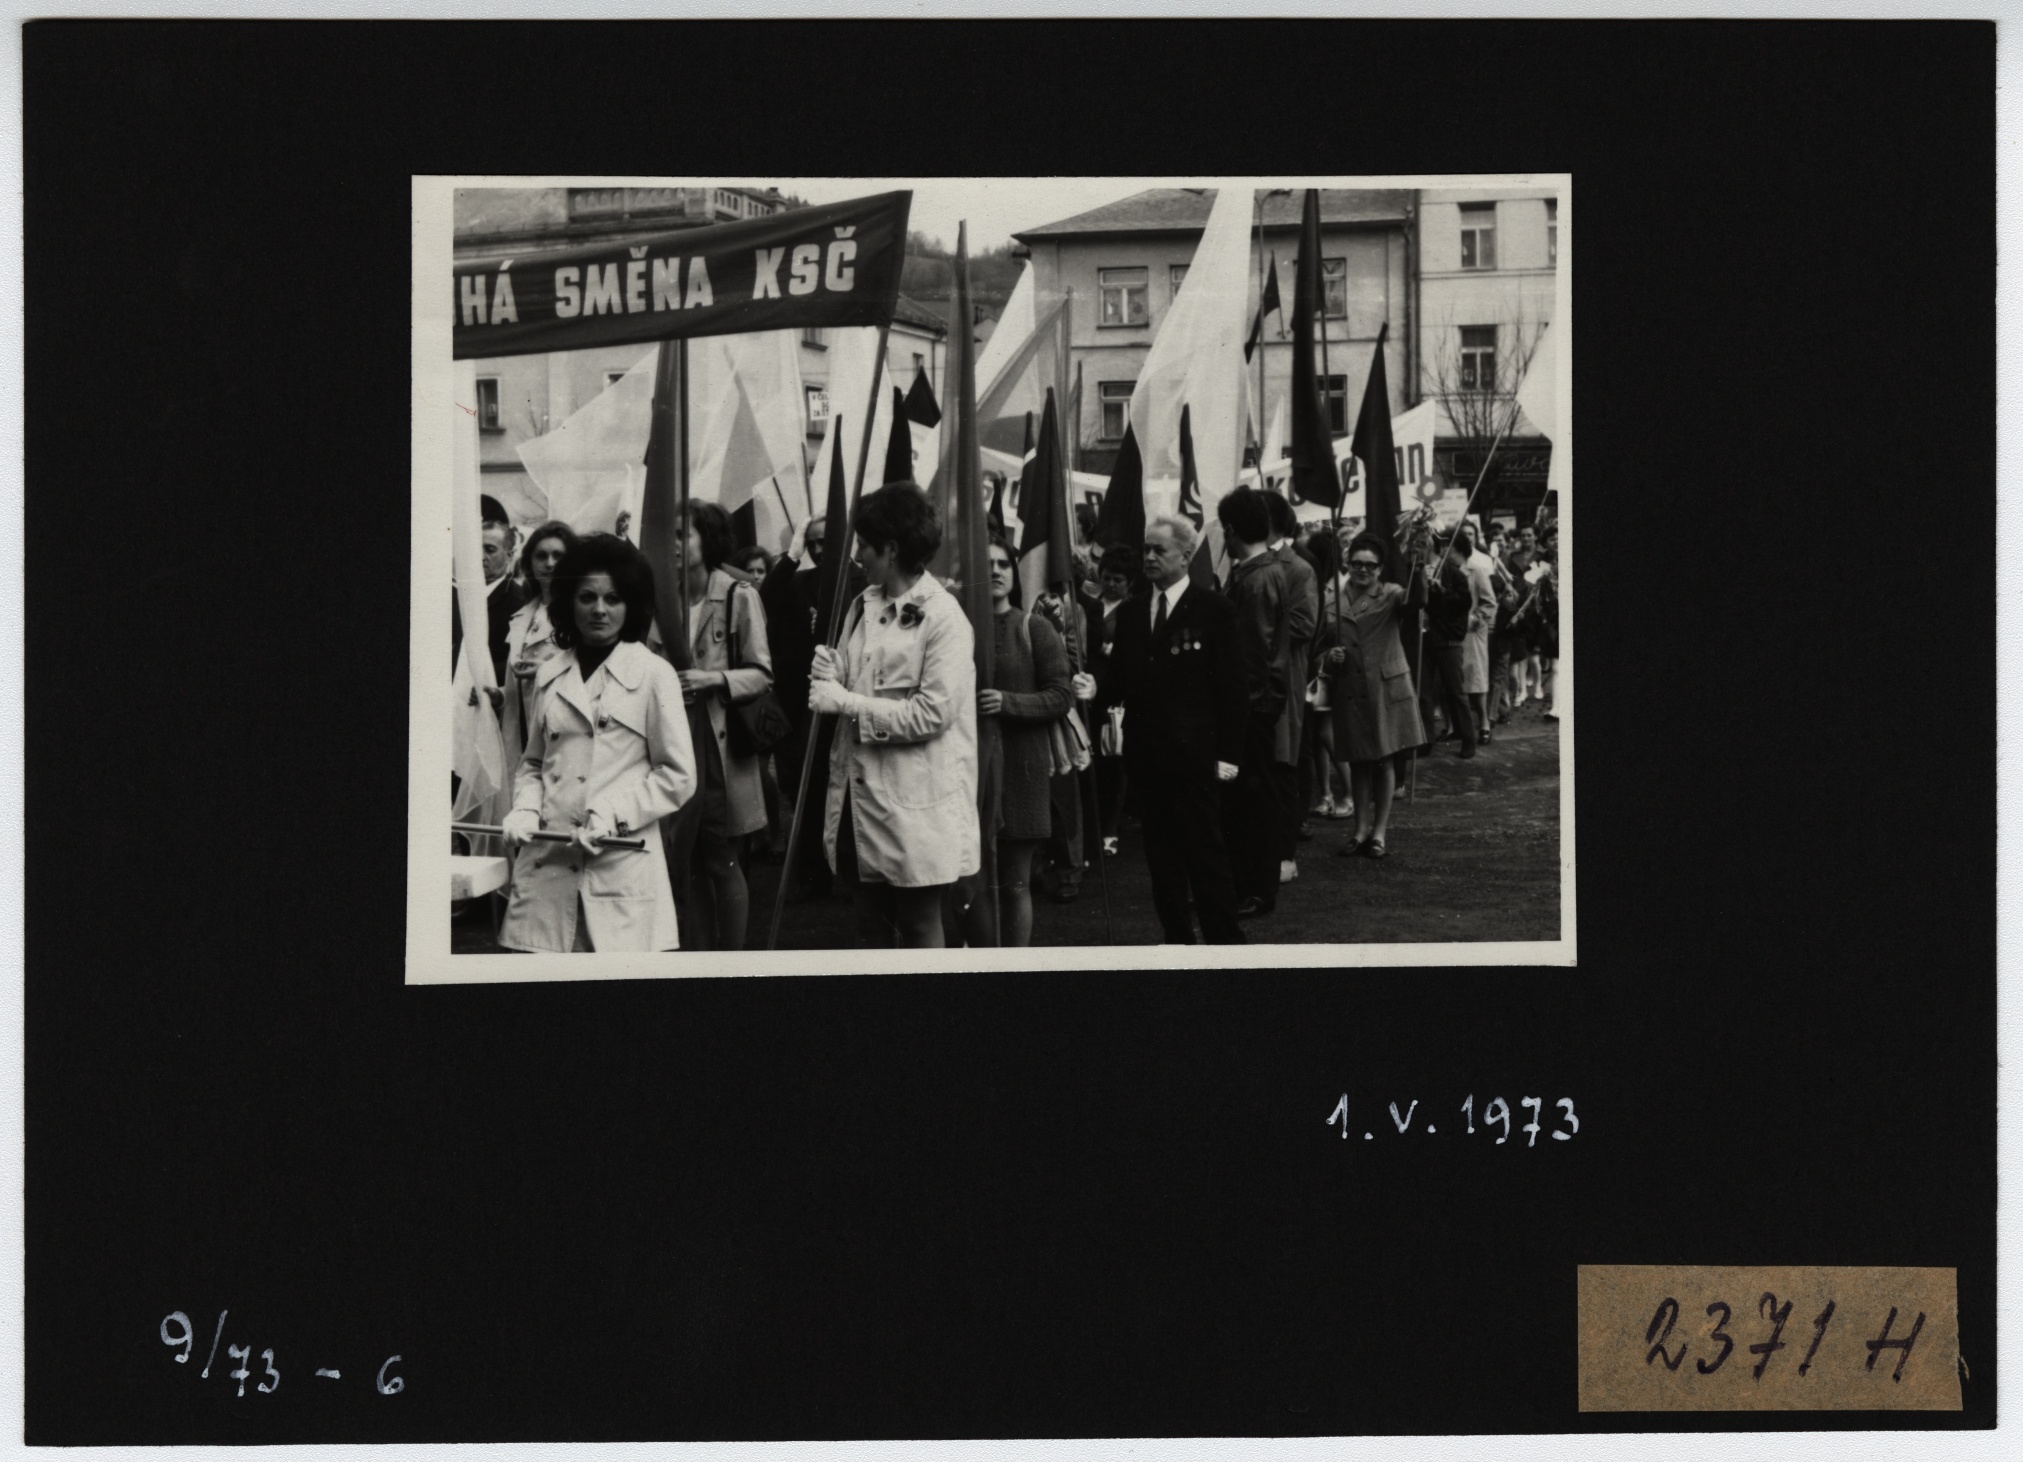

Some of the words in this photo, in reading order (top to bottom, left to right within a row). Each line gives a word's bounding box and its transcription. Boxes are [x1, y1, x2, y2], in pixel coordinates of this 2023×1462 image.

[453, 259, 519, 326] HÁ
[555, 245, 714, 318] SMĚNA
[753, 226, 857, 300] KSČ
[1461, 1094, 1579, 1147] 1973
[160, 1311, 280, 1397] 9/73
[376, 1354, 404, 1394] 6
[1645, 1292, 1835, 1383] 2371
[1866, 1307, 1925, 1383] H
